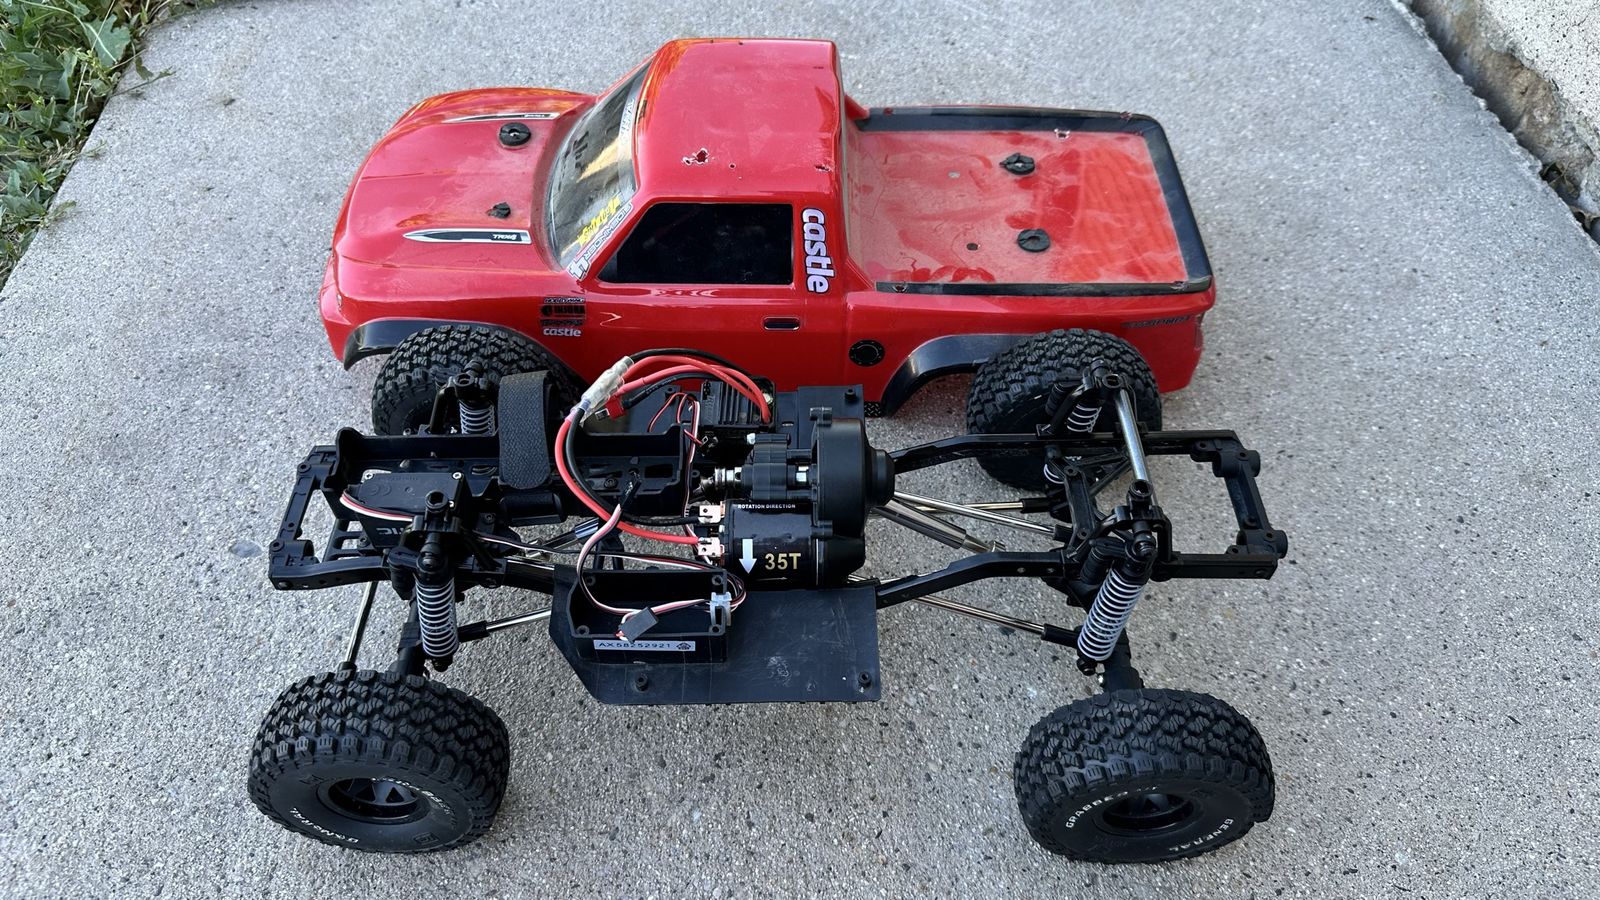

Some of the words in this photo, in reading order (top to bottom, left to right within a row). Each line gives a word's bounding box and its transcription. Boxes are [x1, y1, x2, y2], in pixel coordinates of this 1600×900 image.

[801, 207, 836, 294] castle
[543, 328, 582, 337] castle
[764, 552, 802, 570] 35T
